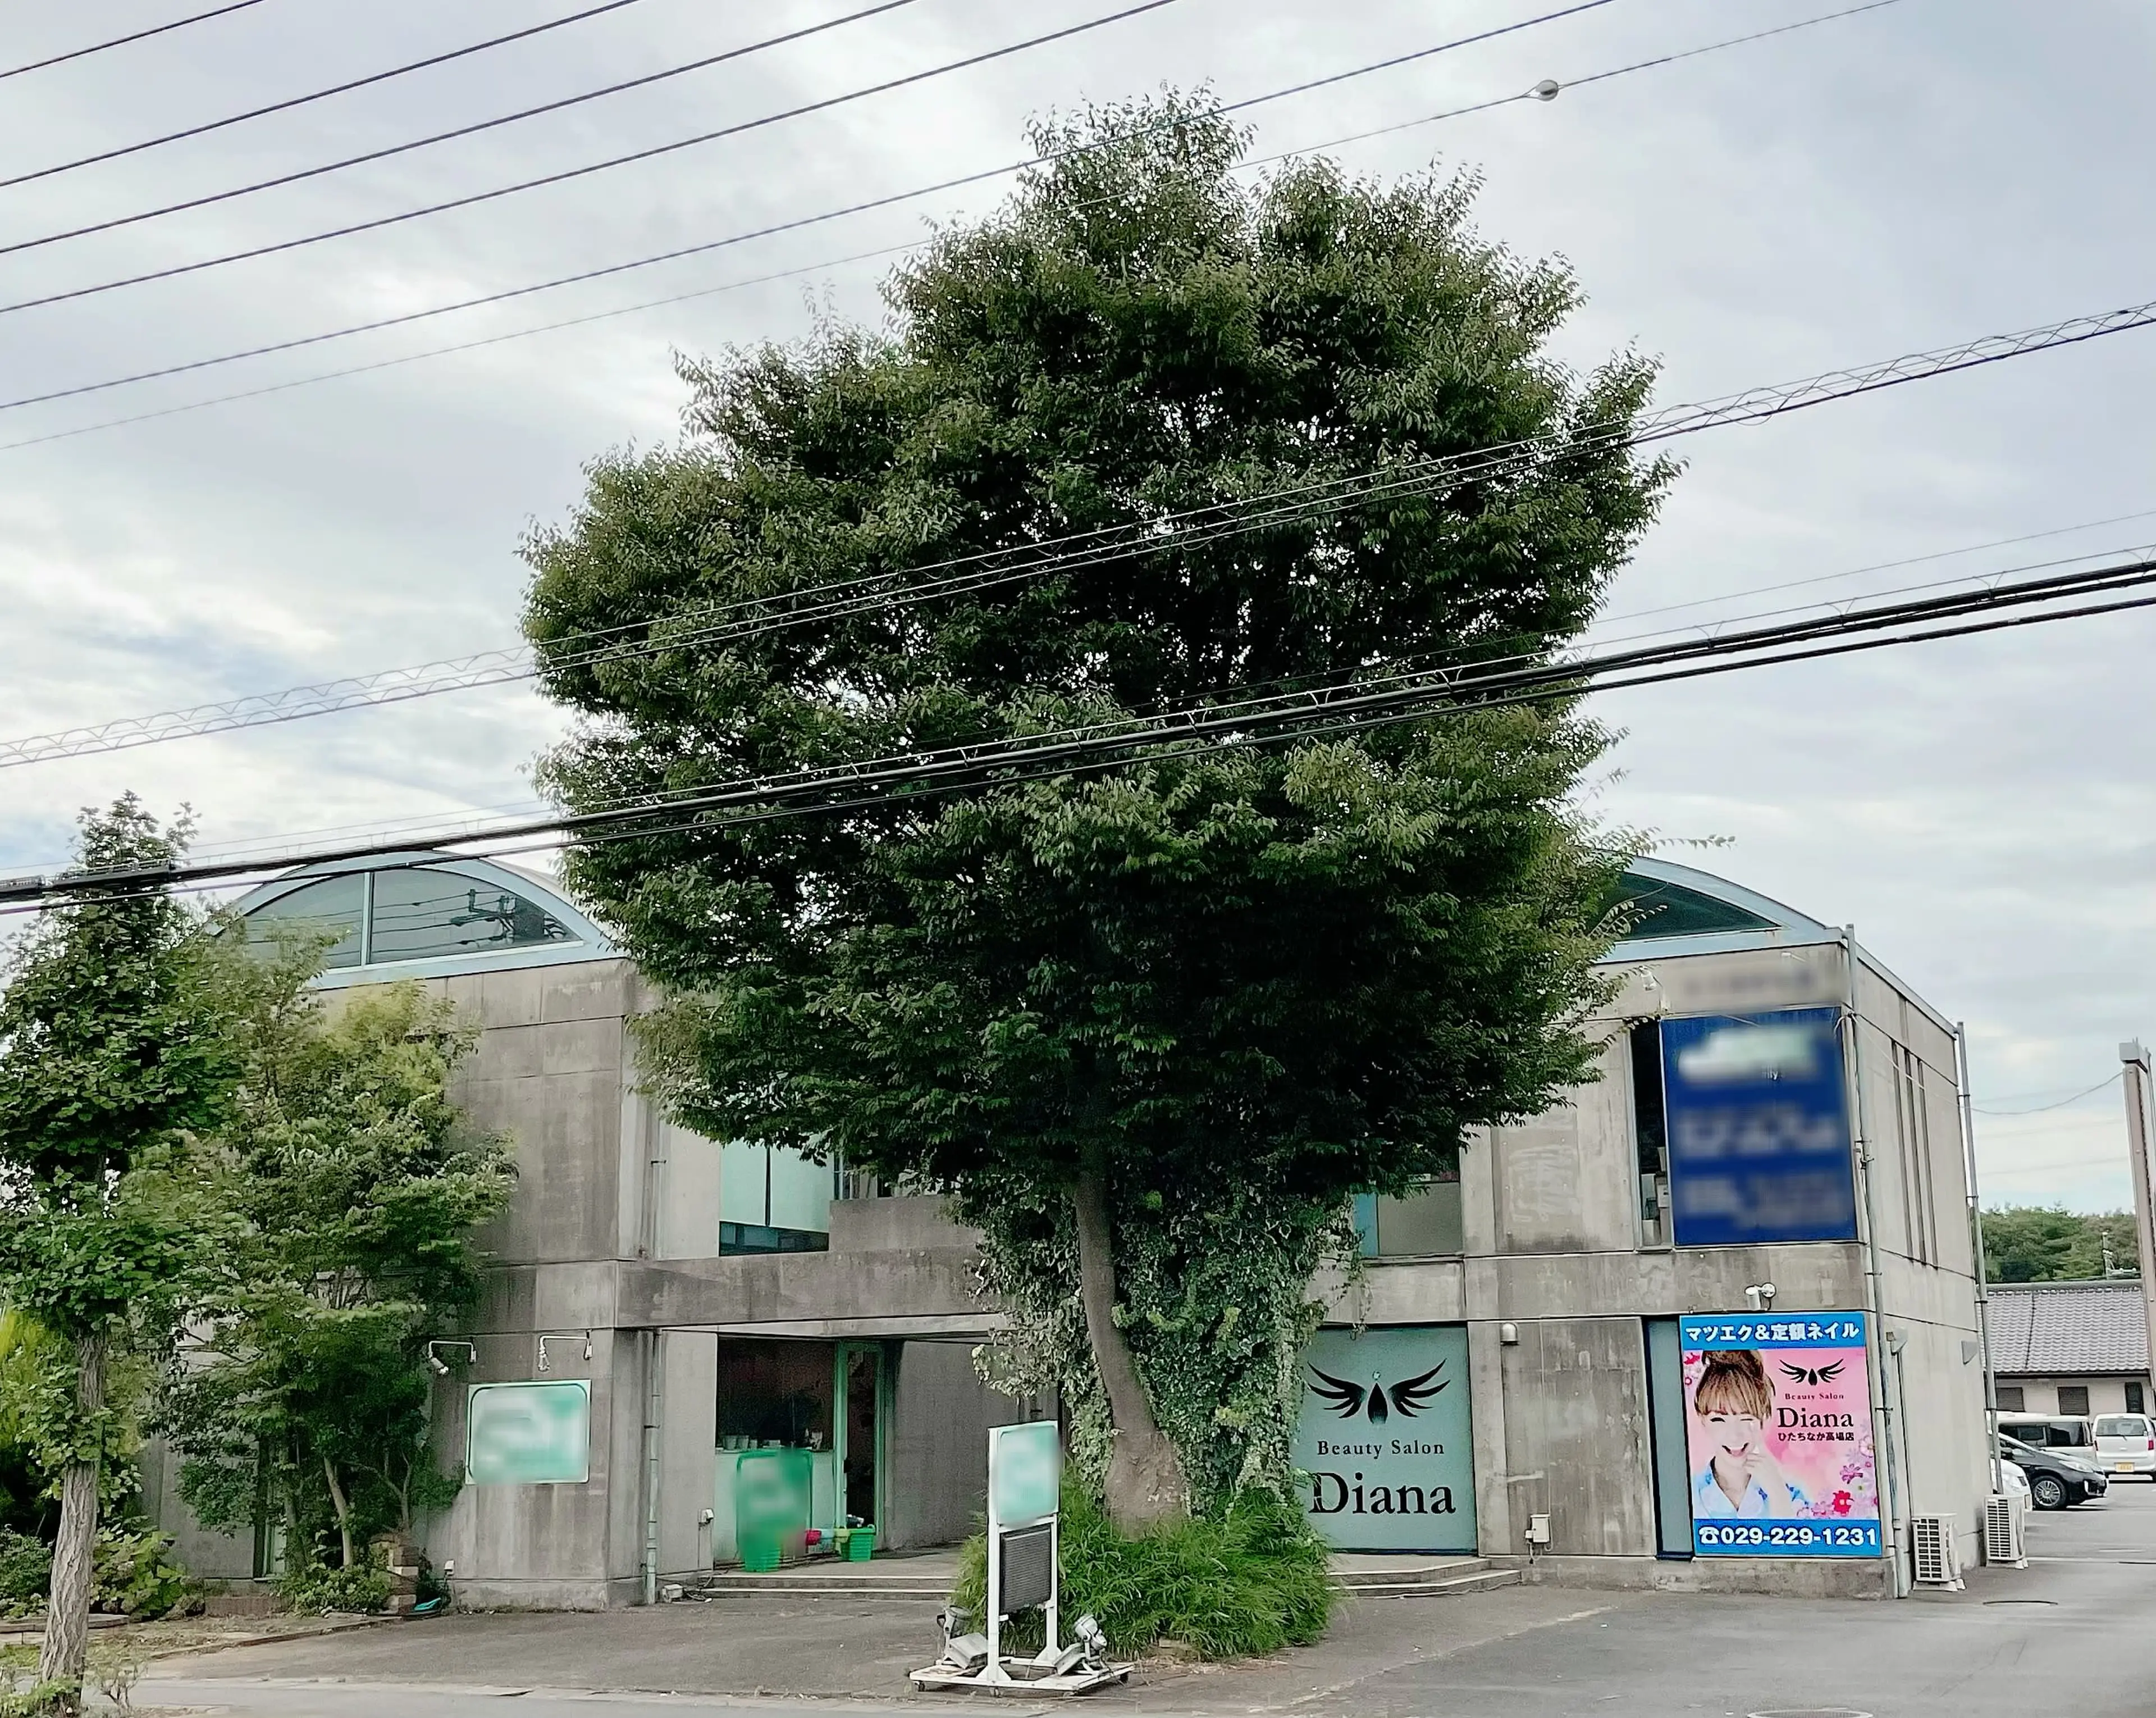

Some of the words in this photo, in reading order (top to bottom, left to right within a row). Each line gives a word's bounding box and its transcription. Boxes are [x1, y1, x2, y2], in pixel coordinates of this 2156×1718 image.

[1685, 1322, 1860, 1341] マツエク&定額ネイル
[1785, 1393, 1815, 1401] Beauty
[1776, 1407, 1854, 1428] Diana
[1317, 1441, 1382, 1459] Beauty
[1392, 1439, 1445, 1454] Salon
[1308, 1471, 1456, 1514] Diana
[1721, 1527, 1876, 1545] 029-229-1231
